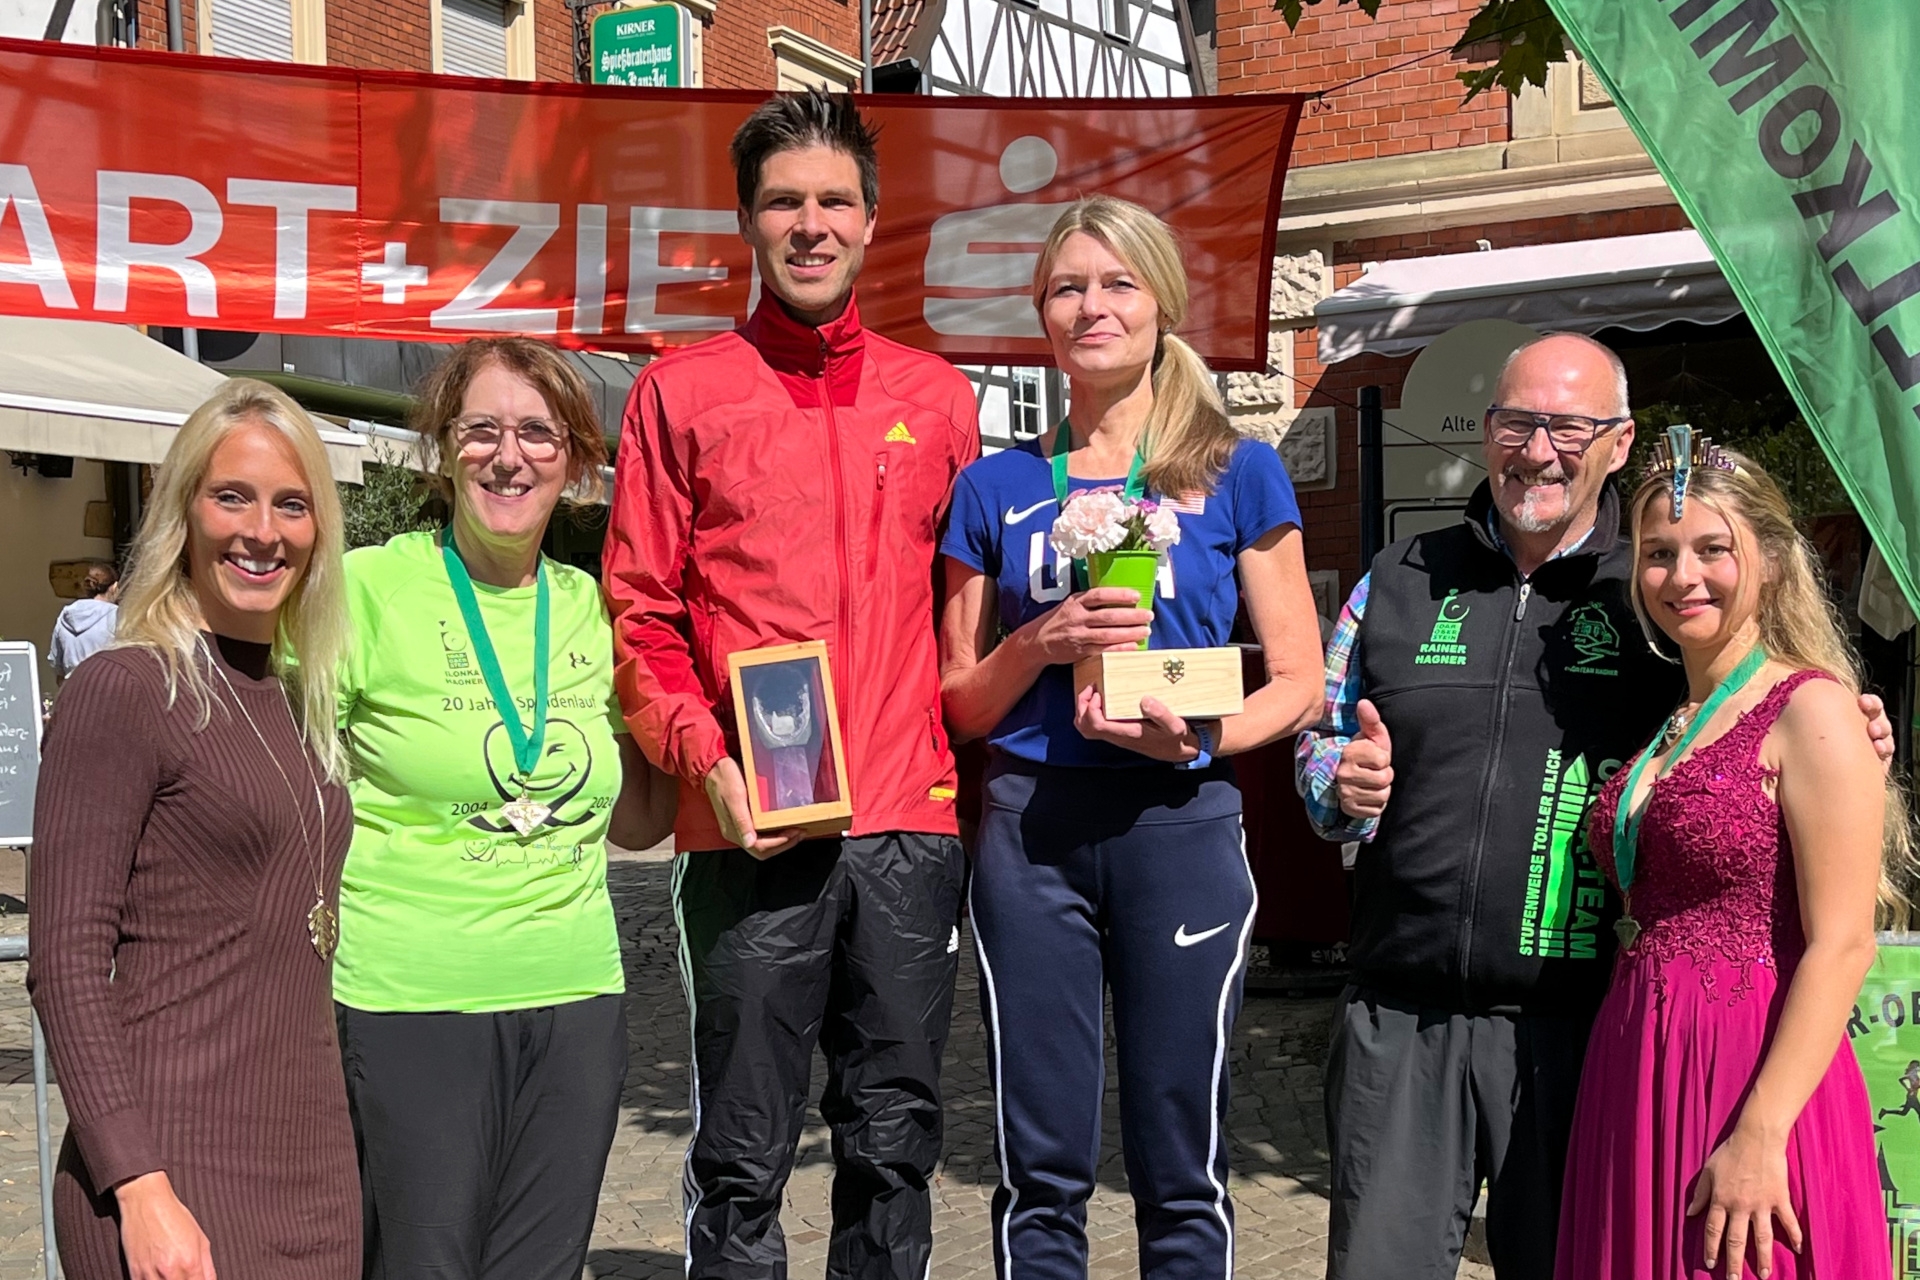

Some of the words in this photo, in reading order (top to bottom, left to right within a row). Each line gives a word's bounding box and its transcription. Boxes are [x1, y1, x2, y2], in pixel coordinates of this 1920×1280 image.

[616, 19, 656, 36] KIRNER
[601, 44, 672, 73] Spießbratenhaus
[1441, 415, 1476, 432] Alte
[1420, 643, 1467, 654] RAINER
[1415, 655, 1467, 665] HAGNER
[445, 670, 480, 678] ILONKA
[442, 697, 463, 711] 20
[516, 693, 596, 711] Spdenlauf
[1542, 747, 1562, 794] BLICK
[451, 802, 489, 816] 2004
[1532, 795, 1554, 851] TOLLER
[1519, 854, 1546, 957] STUFENWEISE
